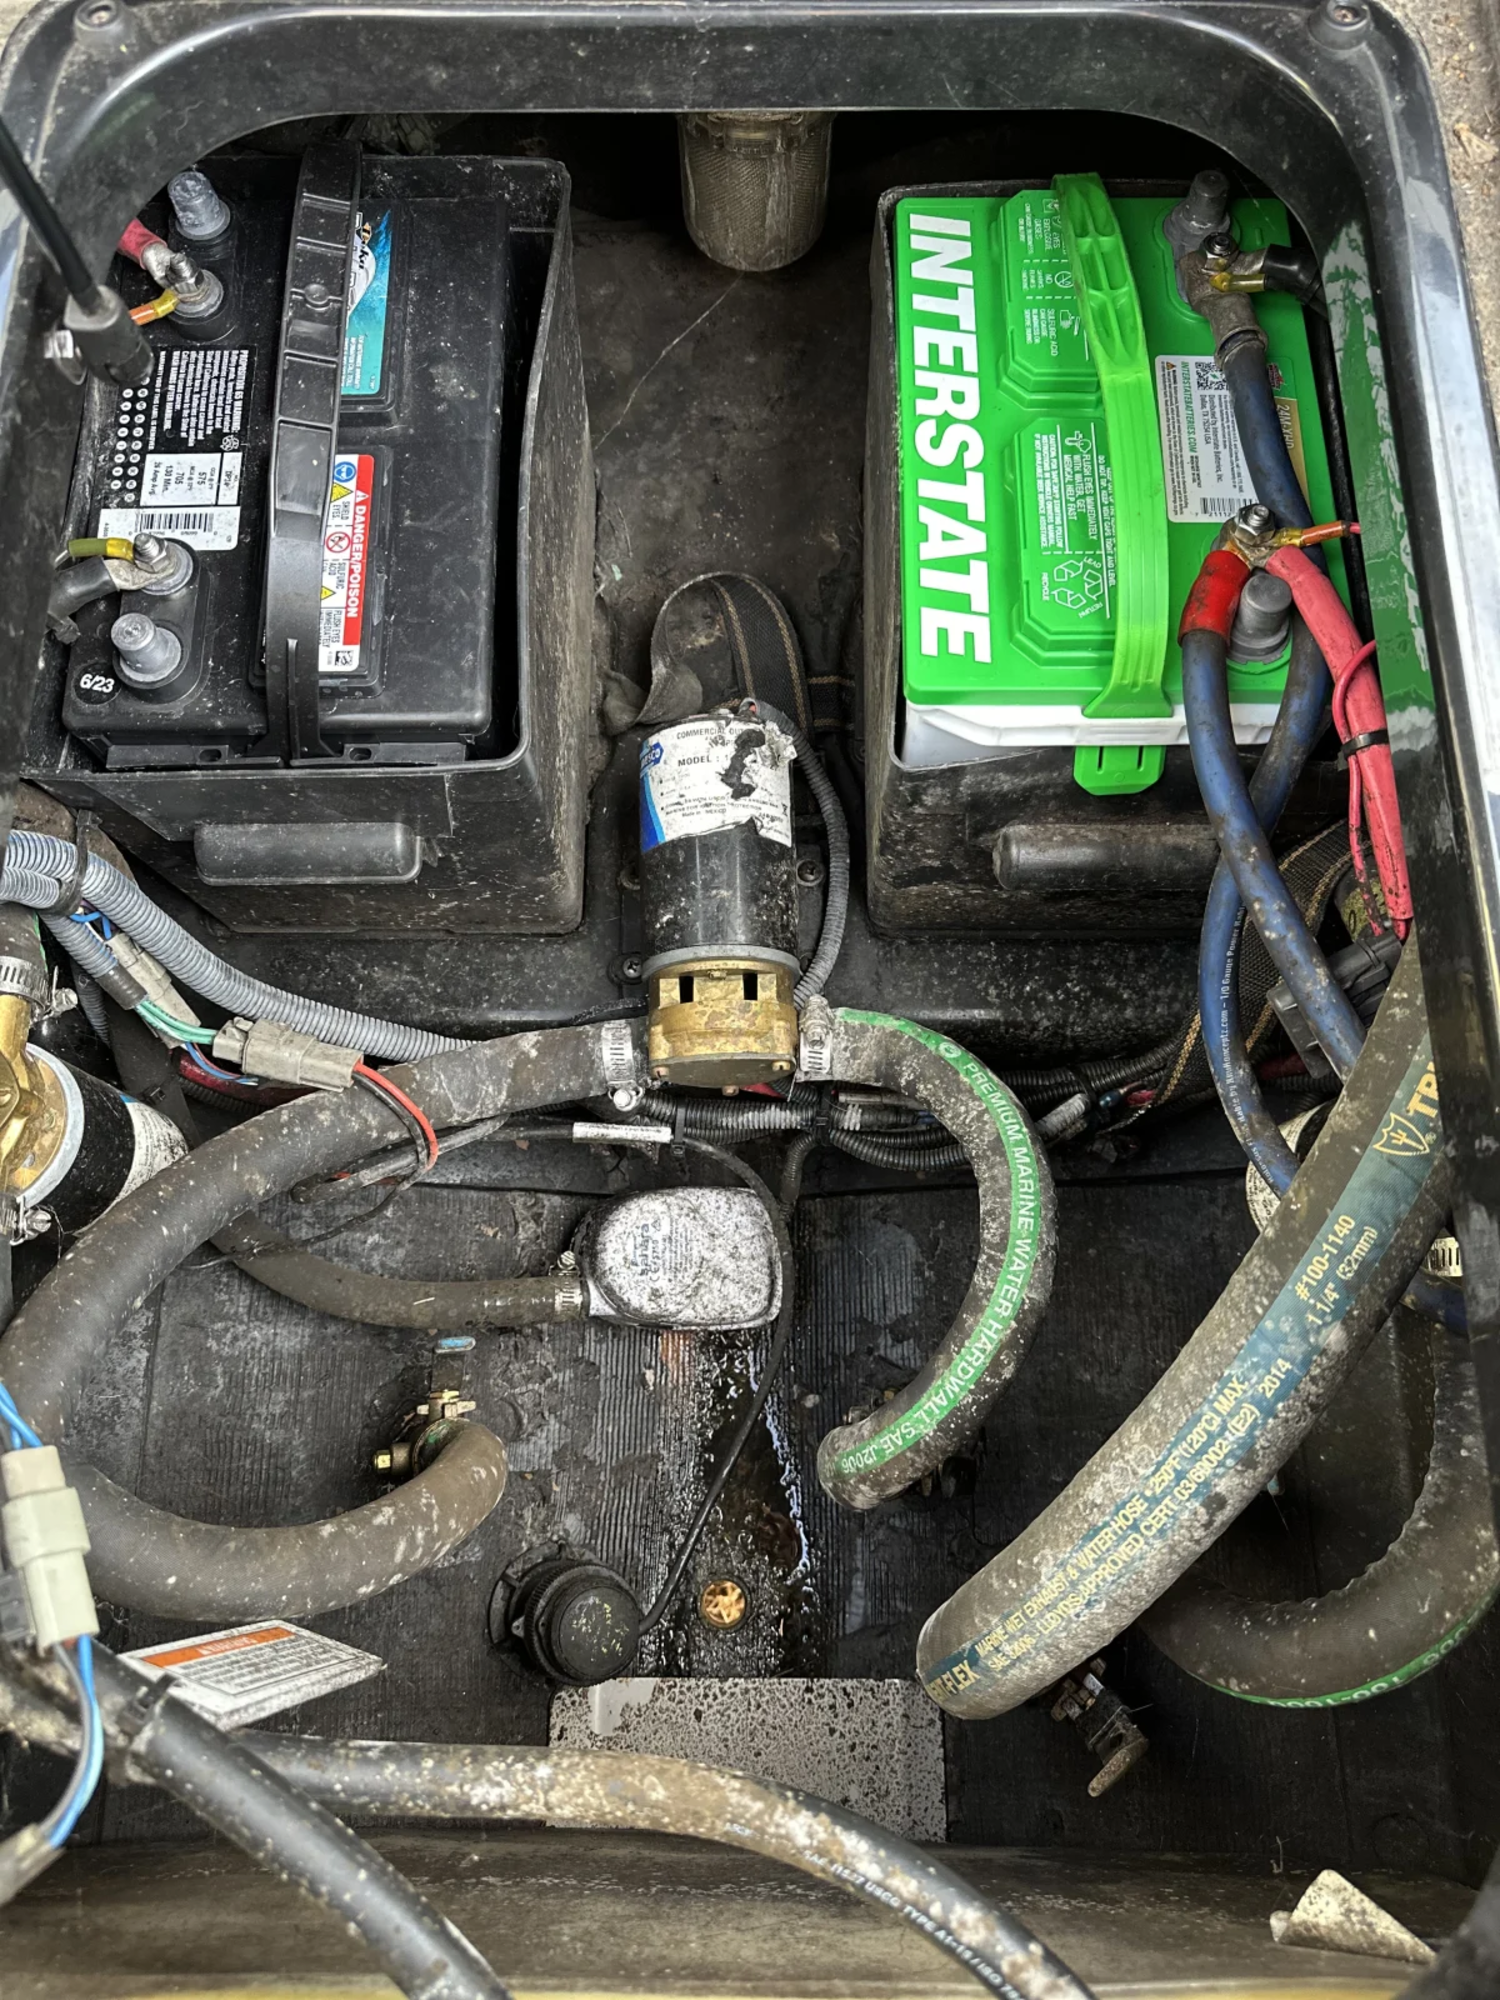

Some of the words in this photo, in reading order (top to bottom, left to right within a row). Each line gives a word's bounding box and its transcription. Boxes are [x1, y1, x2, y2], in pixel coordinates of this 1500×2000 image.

[1047, 309, 1055, 339] SULFURIC
[236, 350, 249, 390] PROPOSITION
[235, 391, 245, 399] 65
[1181, 361, 1197, 453] INTERSTATEBATTERIES.COM
[1199, 394, 1207, 409] Dallas,
[1207, 394, 1216, 417] Distributed
[232, 401, 244, 433] WARNING:
[910, 213, 991, 664] INTERSTATE
[1211, 426, 1220, 450] Interstate
[164, 464, 172, 476] 130
[1064, 455, 1074, 482] MEDICAL
[1073, 455, 1082, 472] WITH
[1083, 455, 1092, 475] FLUSH
[1213, 450, 1222, 473] Batteries,
[162, 478, 171, 493] Min.
[174, 471, 184, 484] 705
[196, 471, 206, 485] 575
[1084, 477, 1094, 494] EYES
[1066, 485, 1075, 501] HELP
[332, 505, 341, 520] EYES.
[341, 501, 350, 520] SHIELD
[1068, 504, 1076, 520] FAST
[1077, 499, 1086, 512] GET
[1086, 496, 1097, 540] IMMEDIATELY
[328, 562, 337, 576] ACID
[347, 505, 366, 617] DANGER/POISON
[336, 562, 346, 589] SULFURIC
[332, 610, 342, 628] FLUSH
[1078, 602, 1103, 618] RETURN
[323, 610, 333, 648] IMMEDIATELY
[331, 629, 340, 643] EYES
[79, 673, 115, 693] 6/23
[677, 728, 727, 740] COMMERCIAL
[678, 755, 712, 767] MODEL
[1226, 928, 1239, 956] Power
[1222, 958, 1234, 984] Gauge
[1219, 985, 1230, 1000] 1/0
[1405, 1061, 1438, 1118] TR
[964, 1062, 1023, 1142] PREMIUM
[1012, 1145, 1035, 1232] MARINE
[1295, 1215, 1356, 1301] #100-1140
[994, 1237, 1032, 1317] WATER
[1307, 1313, 1323, 1325] 1
[1316, 1282, 1340, 1314] 1/4"
[1336, 1226, 1378, 1280] (32mm)
[914, 1319, 1004, 1421] HARDWALL
[880, 1423, 917, 1454] SAE
[841, 1443, 878, 1473] J2006
[988, 1653, 1011, 1672] SAE
[1080, 1533, 1144, 1597] APPROVED
[1140, 1496, 1178, 1536] CERT
[1227, 1403, 1260, 1437] (E2)
[1259, 1358, 1292, 1398] 2014
[975, 1625, 1009, 1658] MARINE
[1004, 1610, 1027, 1633] WET
[1024, 1571, 1070, 1618] EXHAUST
[1066, 1565, 1079, 1580] &
[1076, 1527, 1116, 1570] WATER
[1110, 1495, 1148, 1535] HOSE
[864, 1881, 900, 1908] USCG
[903, 1904, 937, 1932] TYPE
[977, 1961, 1003, 1986] ISO
